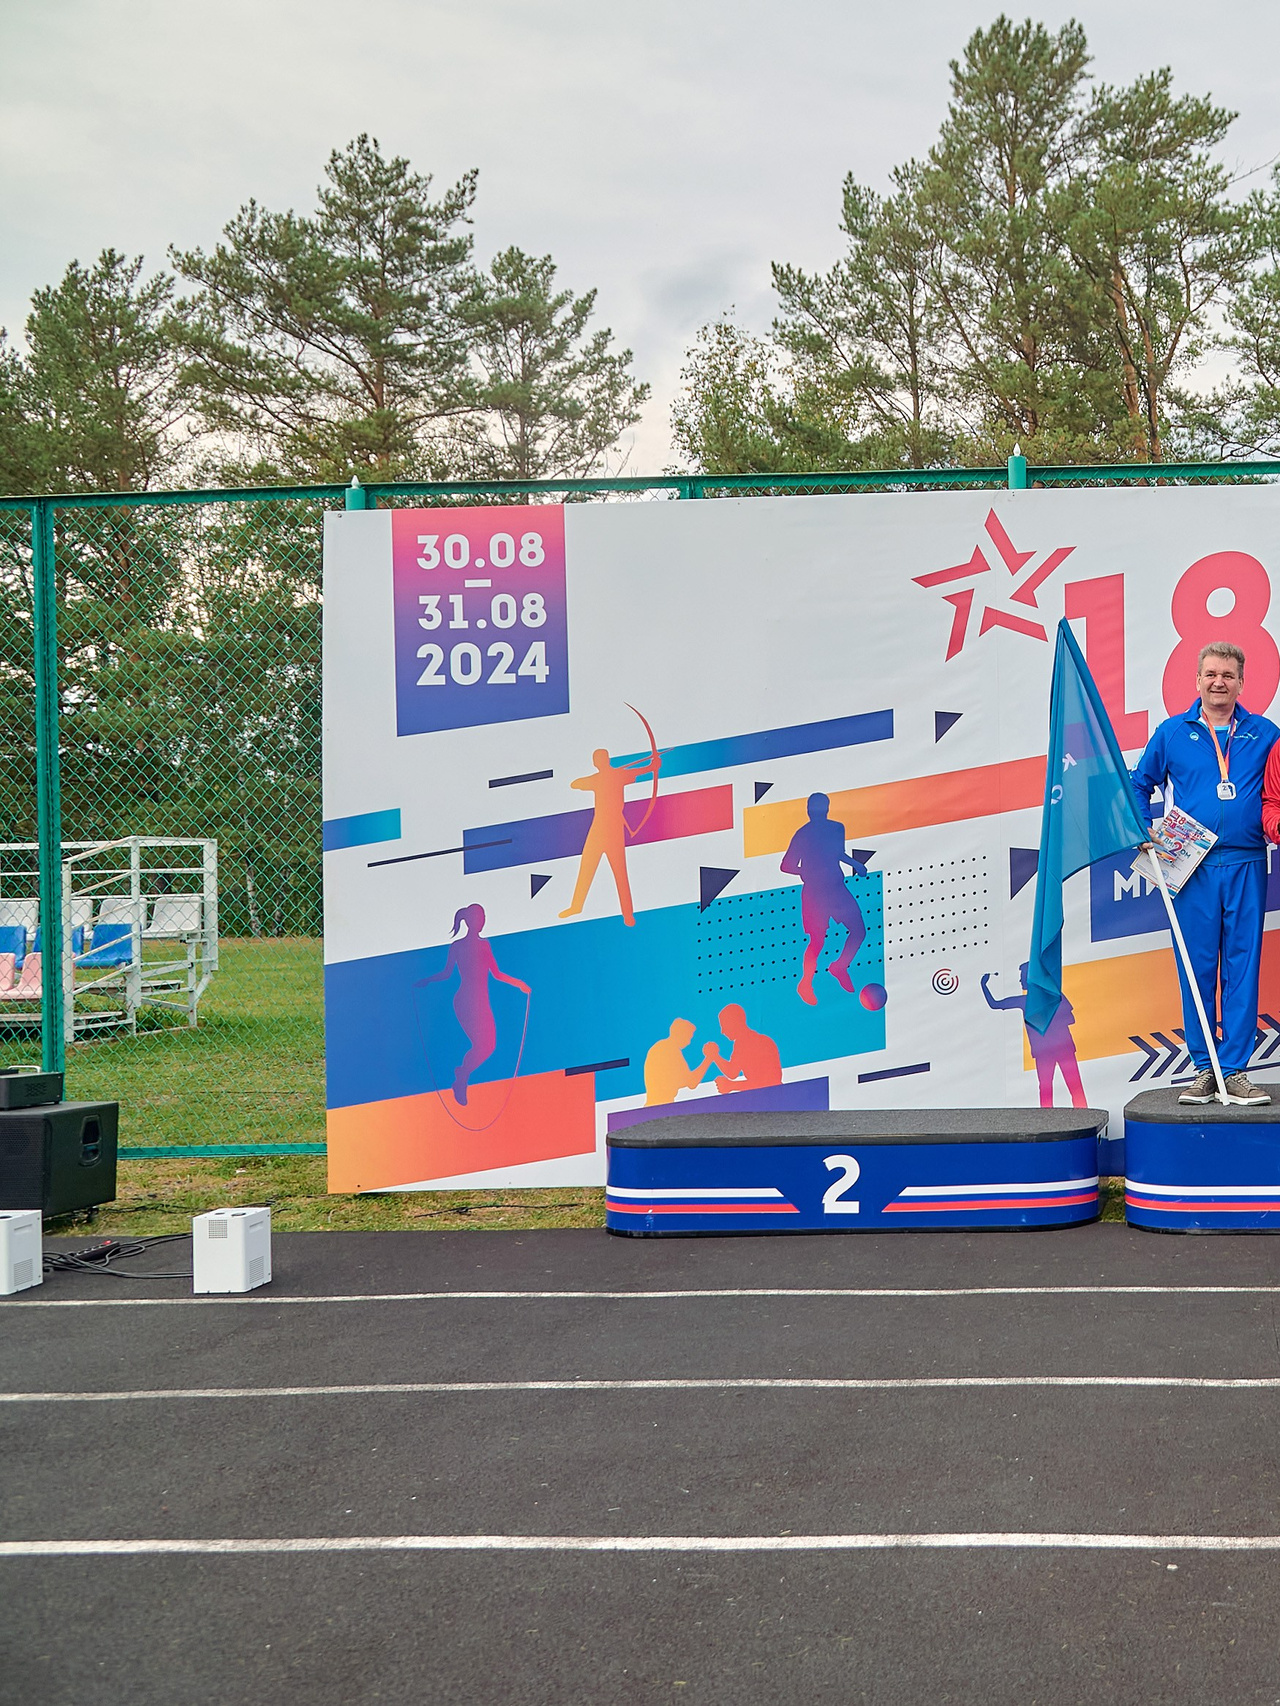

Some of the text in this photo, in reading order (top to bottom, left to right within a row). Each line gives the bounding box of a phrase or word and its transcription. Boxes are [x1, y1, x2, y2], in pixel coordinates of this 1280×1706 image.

[416, 532, 545, 570] 30.08
[418, 592, 547, 630] 31.08
[416, 641, 549, 686] 2024
[1064, 551, 1280, 752] 18
[822, 1154, 860, 1214] 2
